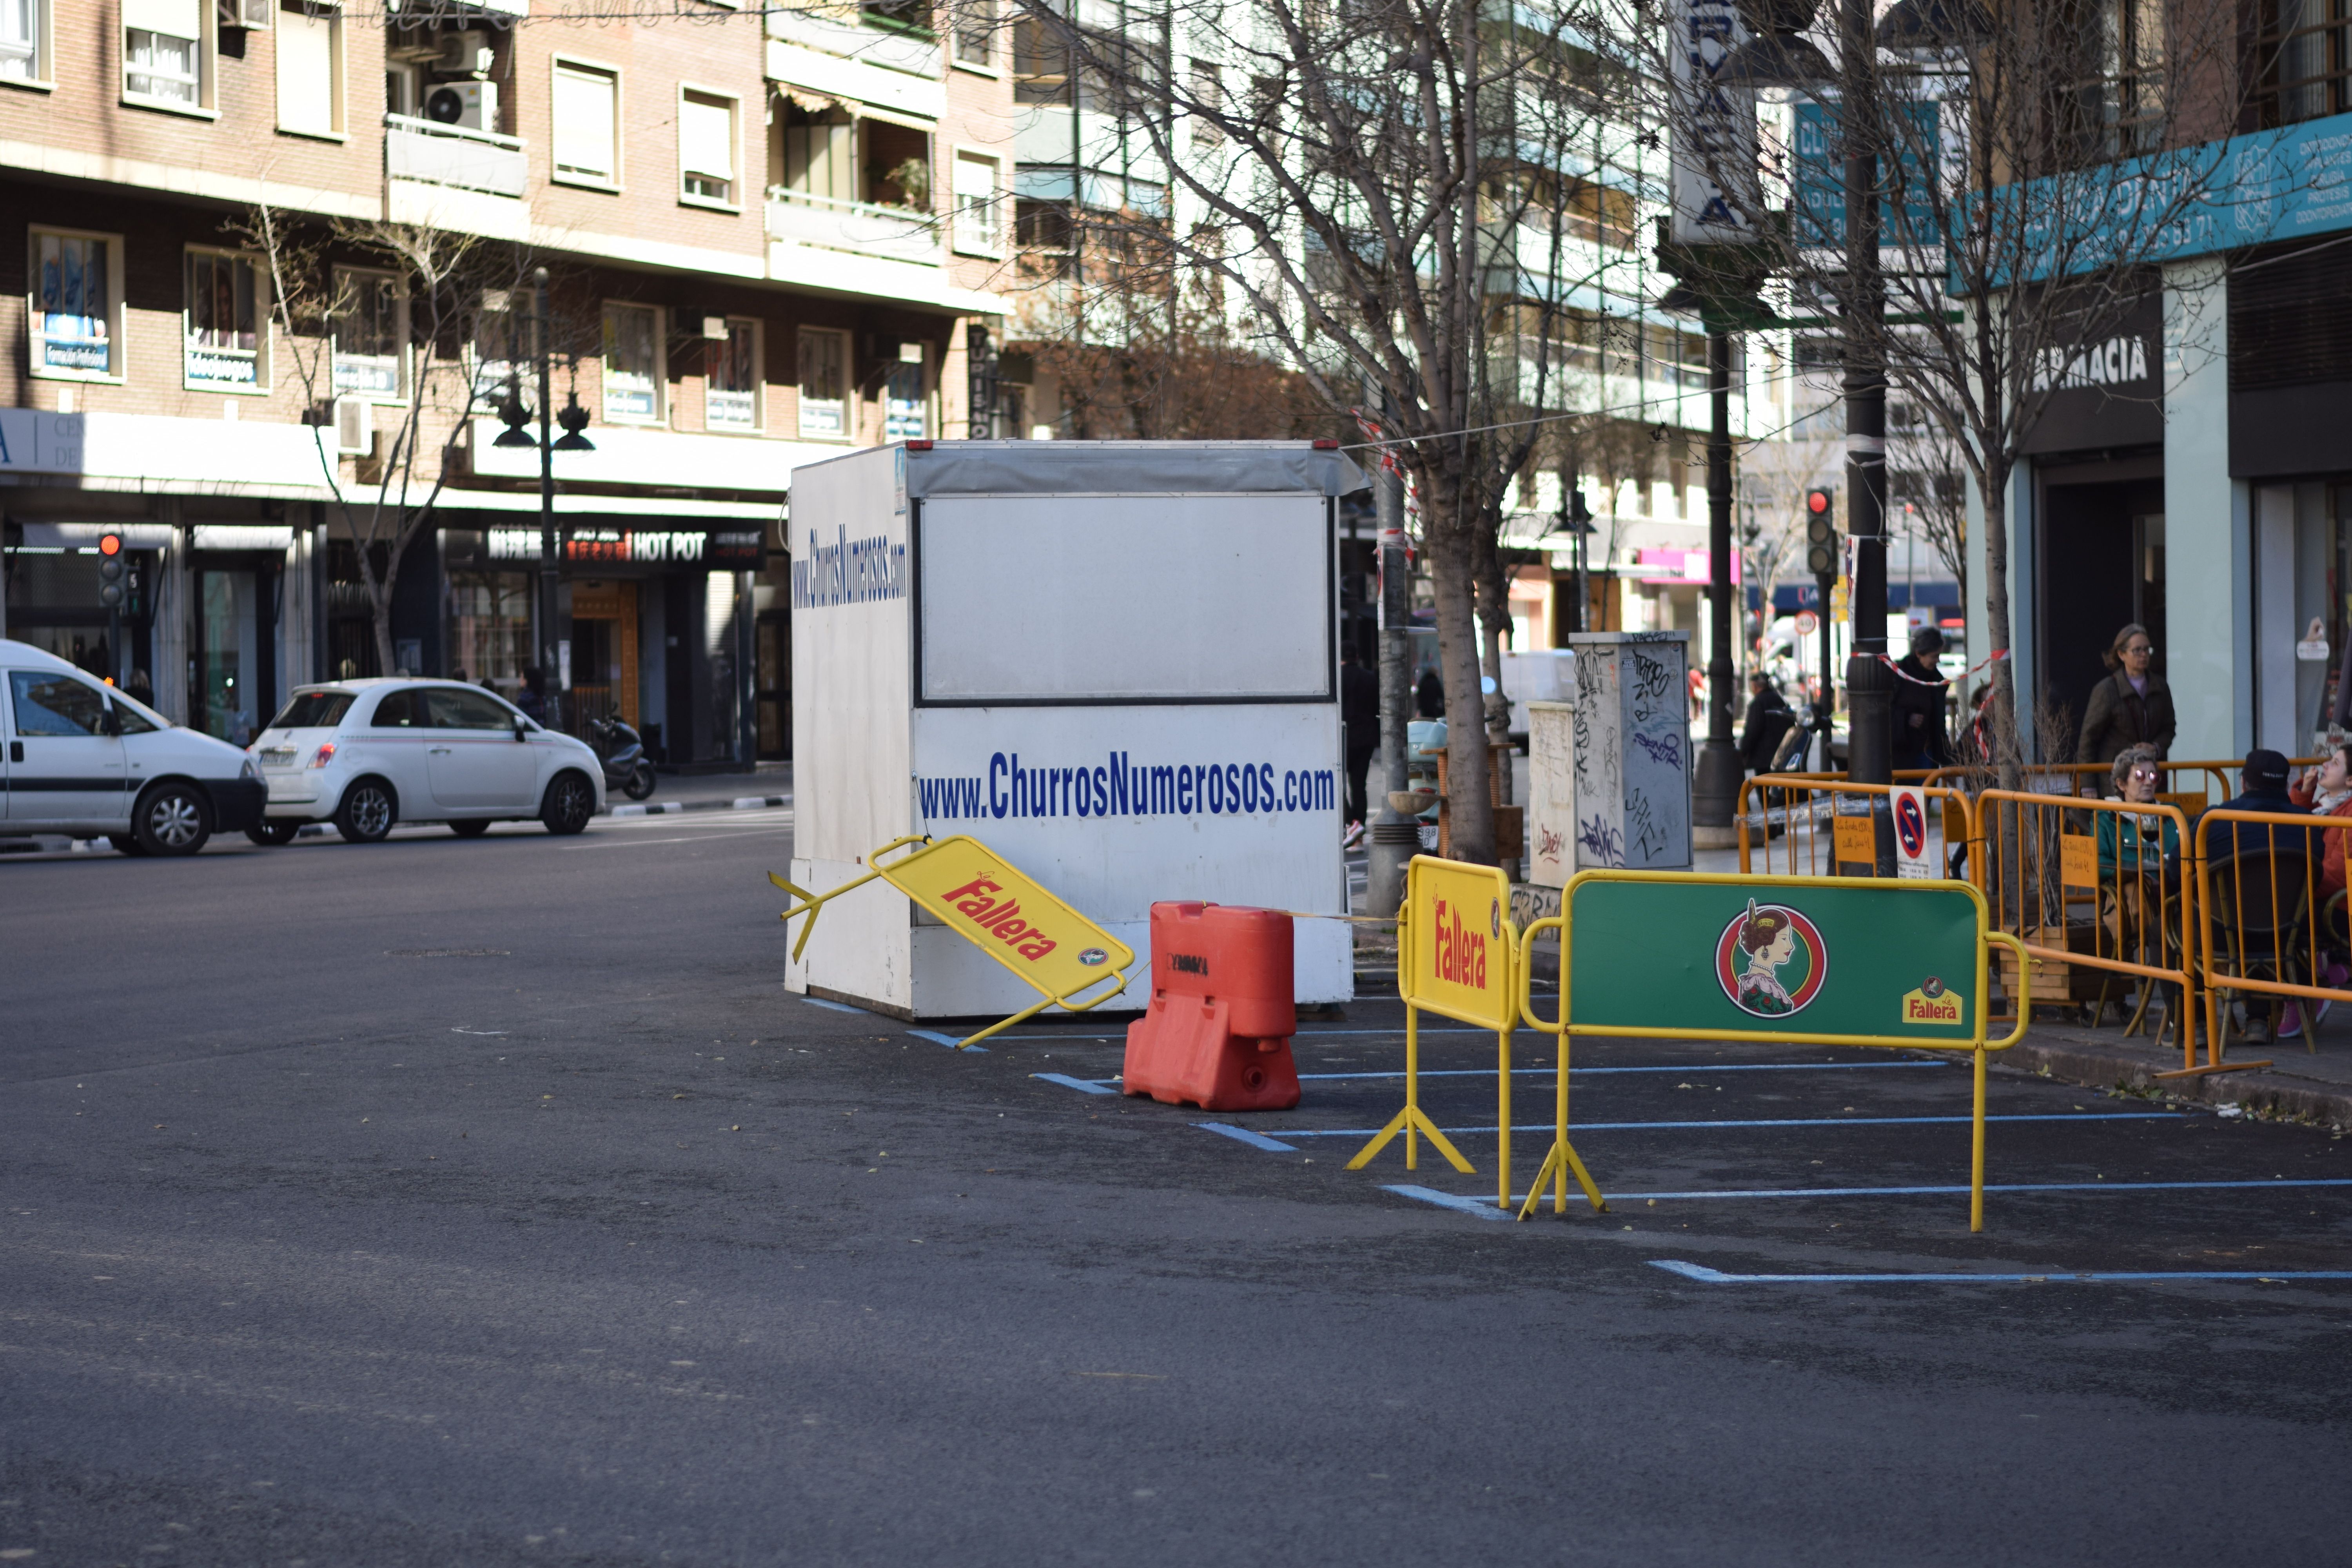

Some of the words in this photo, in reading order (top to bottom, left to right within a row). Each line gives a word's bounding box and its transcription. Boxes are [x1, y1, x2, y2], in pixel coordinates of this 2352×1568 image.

[2023, 334, 2148, 393] ARMACIA
[634, 532, 670, 561] HOT
[671, 532, 707, 561] POT
[793, 523, 906, 609] www.ChurrosNumerosos.com
[919, 750, 1334, 819] www.ChurrosNumerosos.com
[940, 878, 1057, 962] Fallera
[1435, 899, 1486, 990] Fallera
[1909, 998, 1956, 1019] Fallera
[1942, 995, 1953, 1006] La
